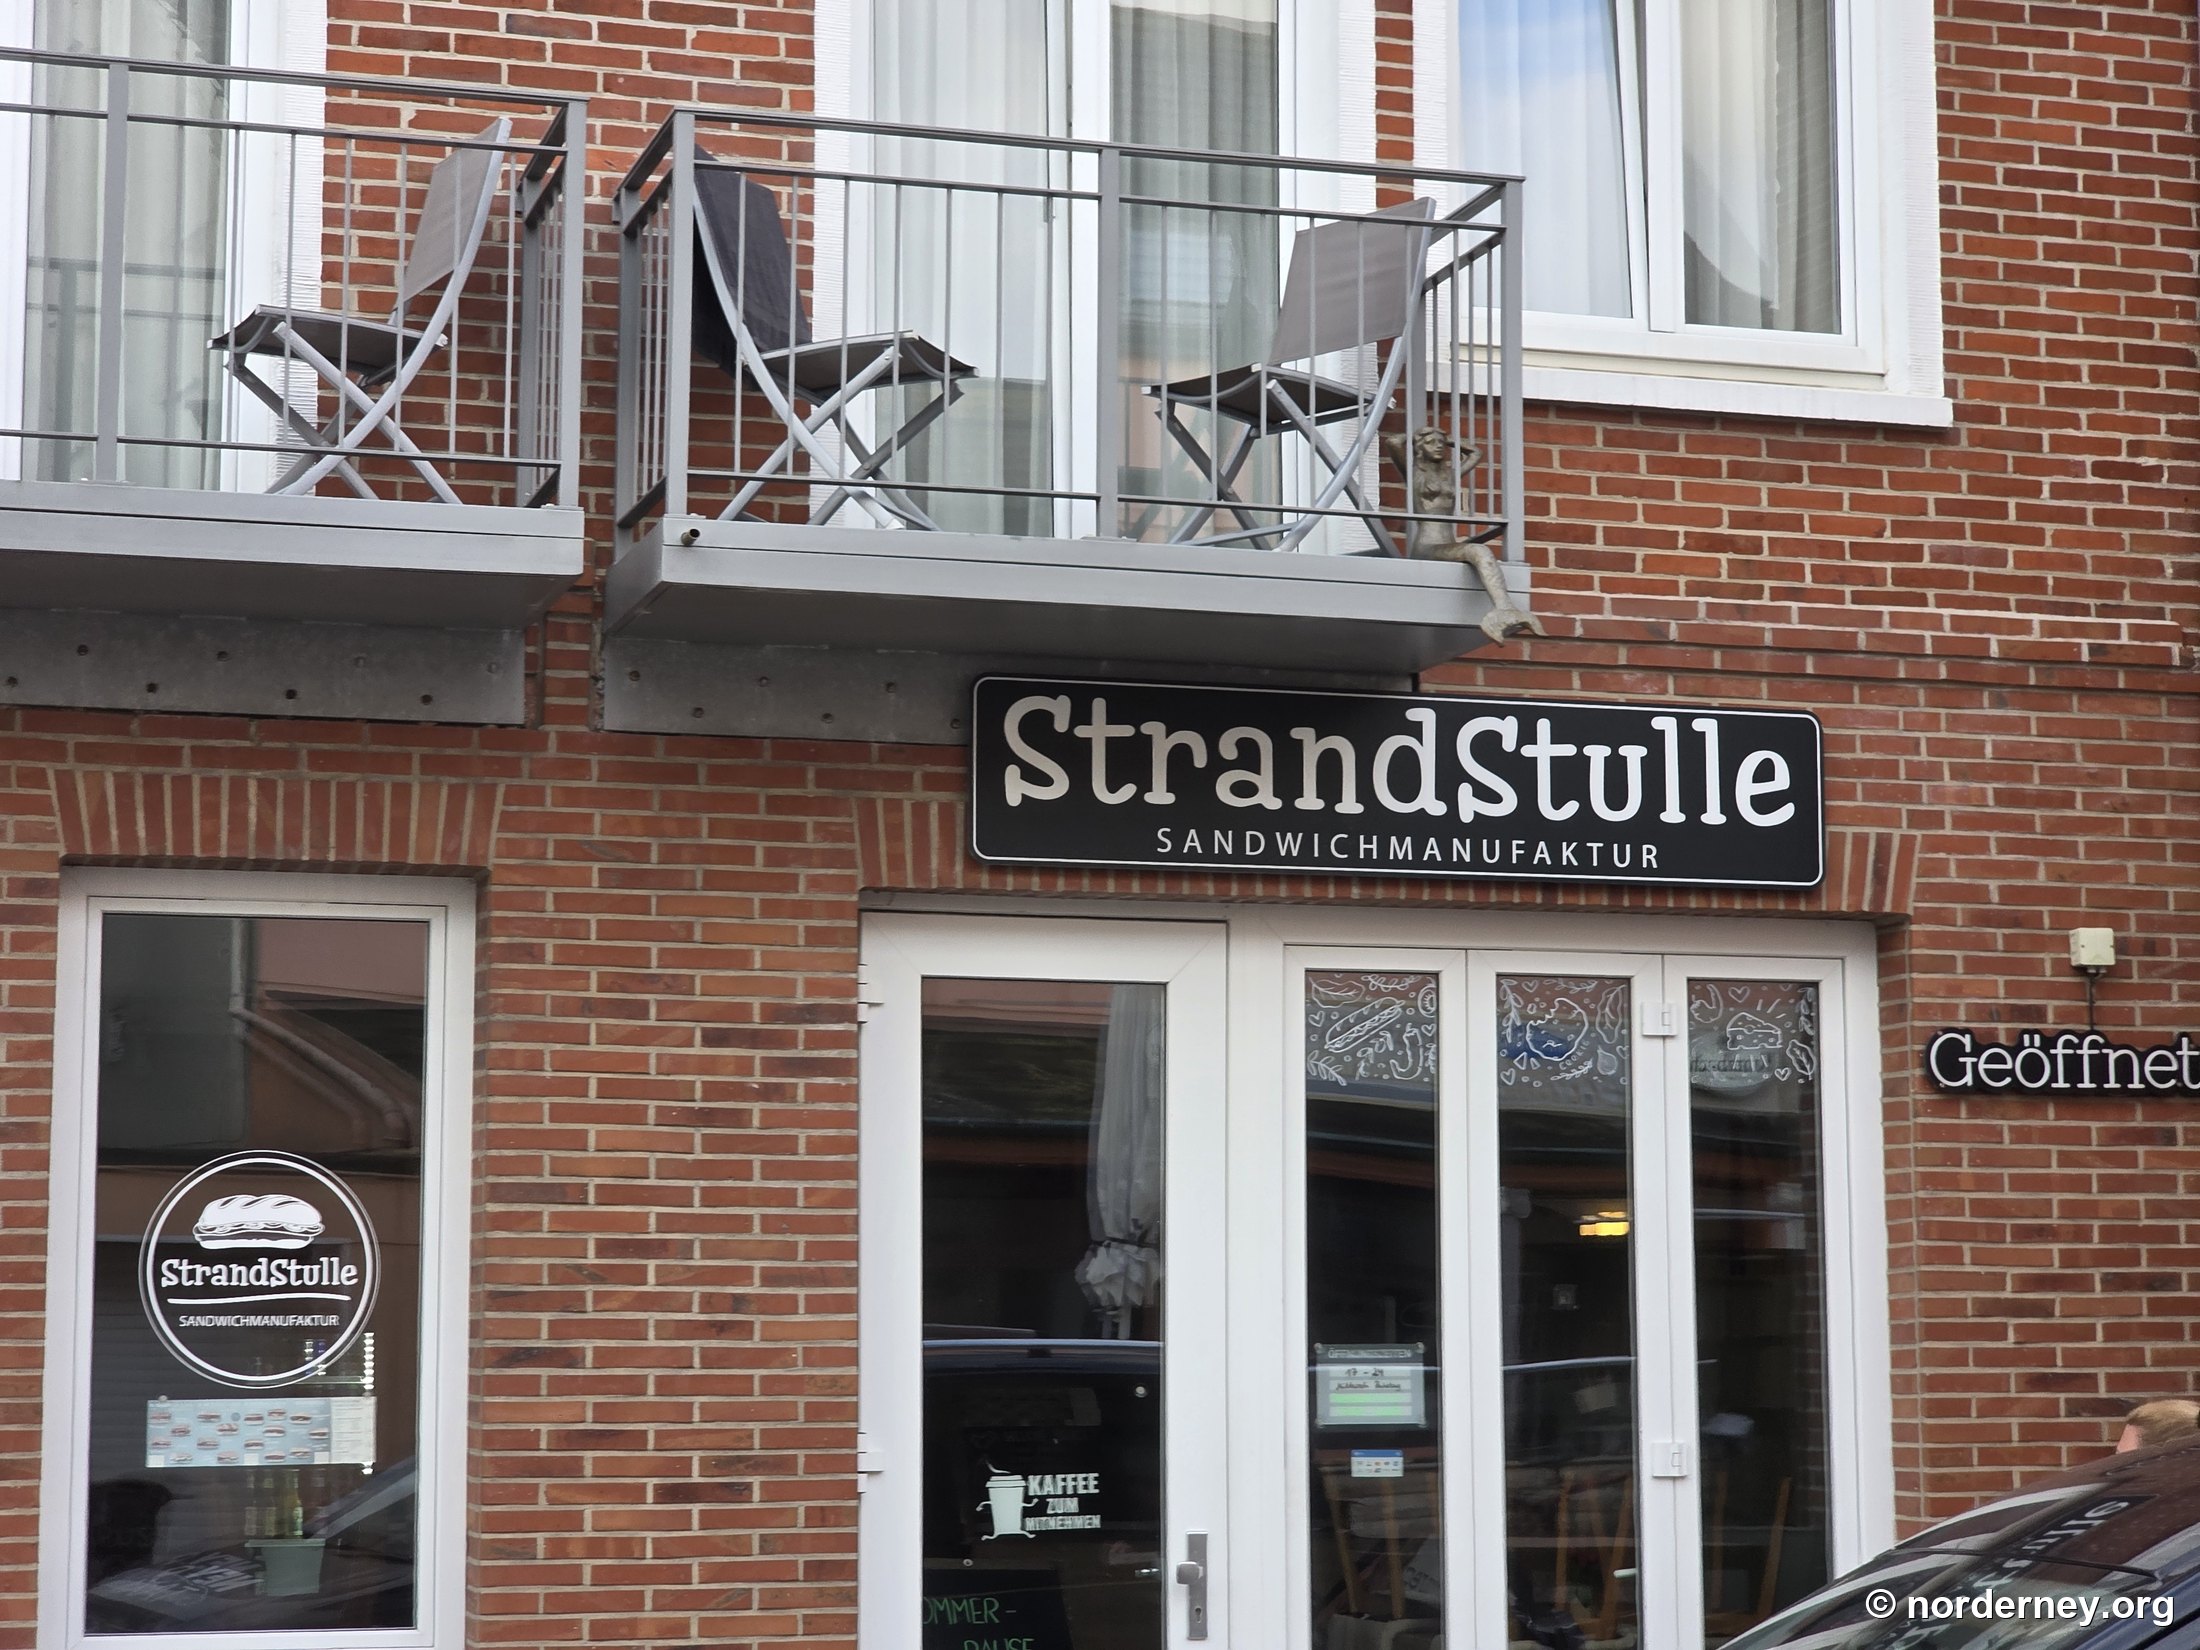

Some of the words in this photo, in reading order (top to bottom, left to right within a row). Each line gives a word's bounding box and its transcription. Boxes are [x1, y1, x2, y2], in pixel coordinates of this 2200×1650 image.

[1003, 695, 1795, 827] StrandStulle
[1156, 827, 1660, 869] SANDWICHMANUFAKTUR
[1929, 1032, 2200, 1089] Geöffnet
[161, 1257, 358, 1287] StrandStulle
[179, 1315, 340, 1327] SANDWICHMANUFAKTUR
[1028, 1473, 1100, 1496] KAFFEE
[1046, 1497, 1079, 1514] ZUM
